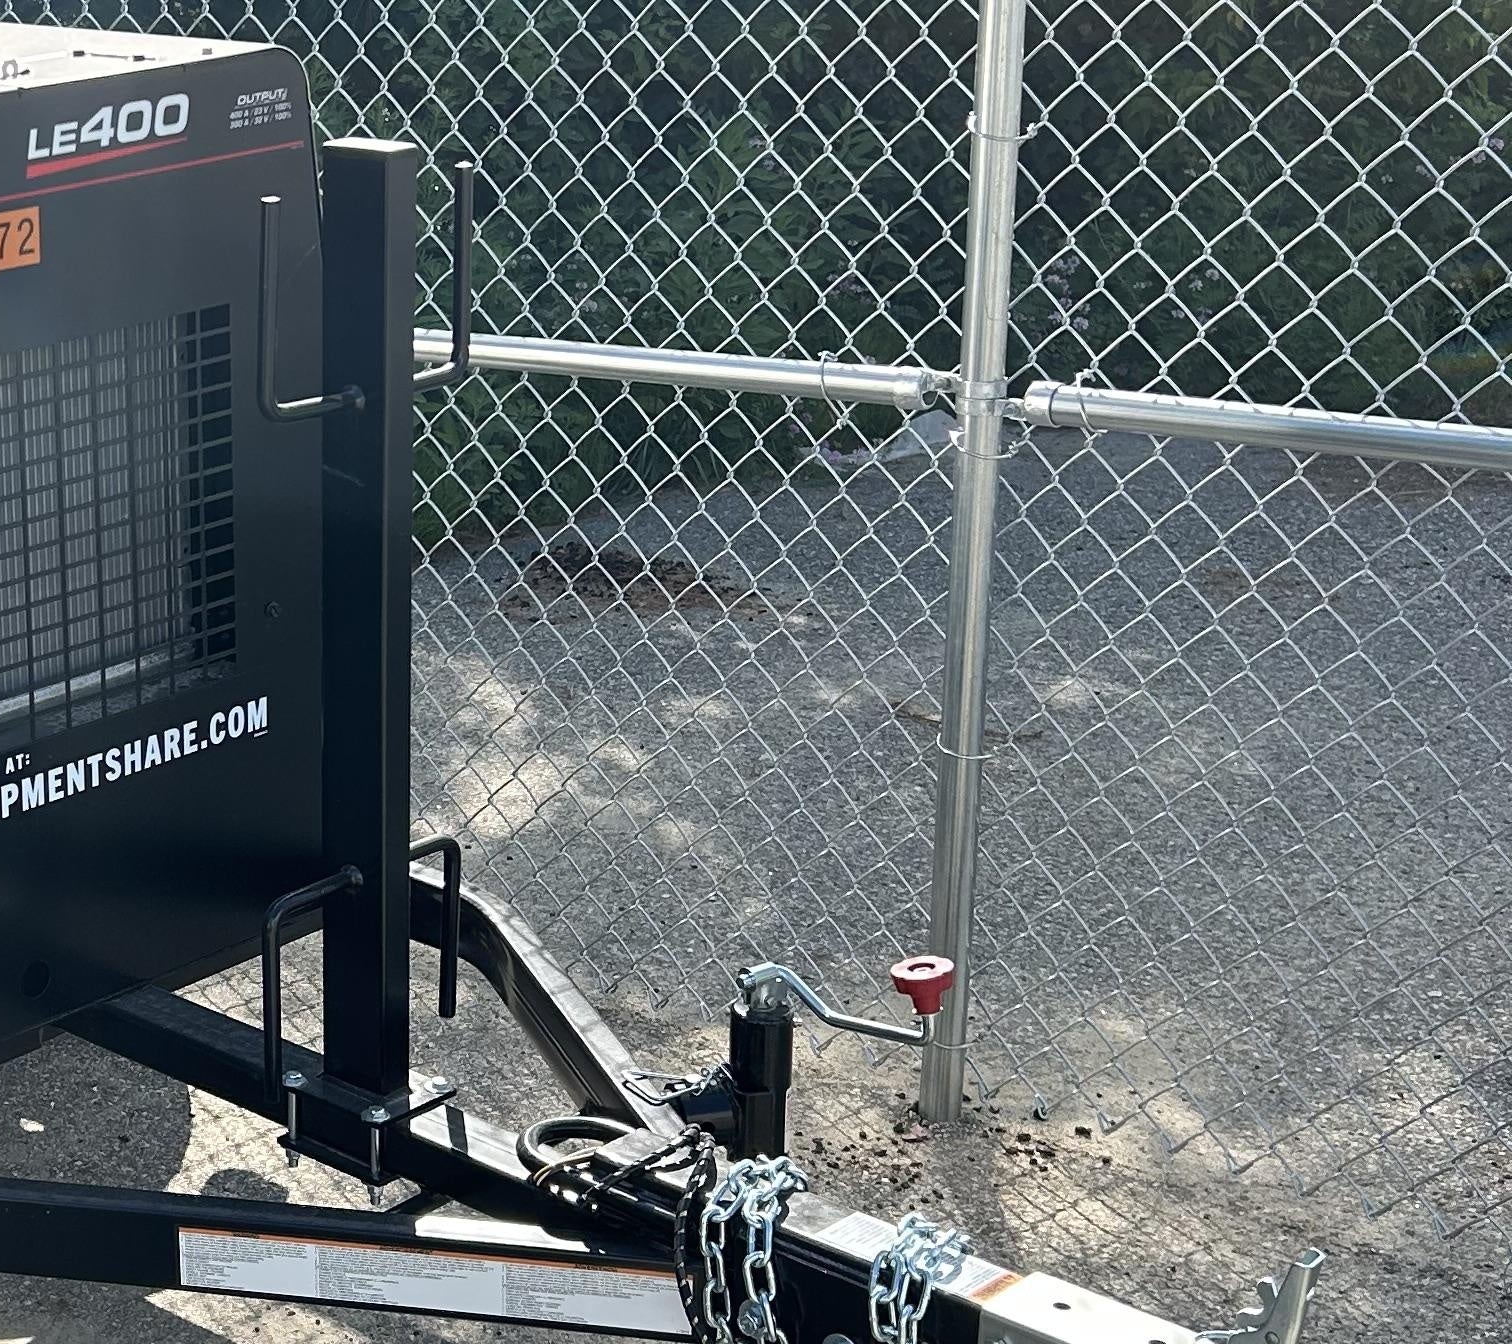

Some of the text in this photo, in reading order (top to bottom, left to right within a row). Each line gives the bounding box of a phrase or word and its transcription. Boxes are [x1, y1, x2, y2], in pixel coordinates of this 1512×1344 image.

[237, 88, 285, 106] OUTPUT
[27, 93, 189, 160] LE400
[5, 753, 31, 775] AT:
